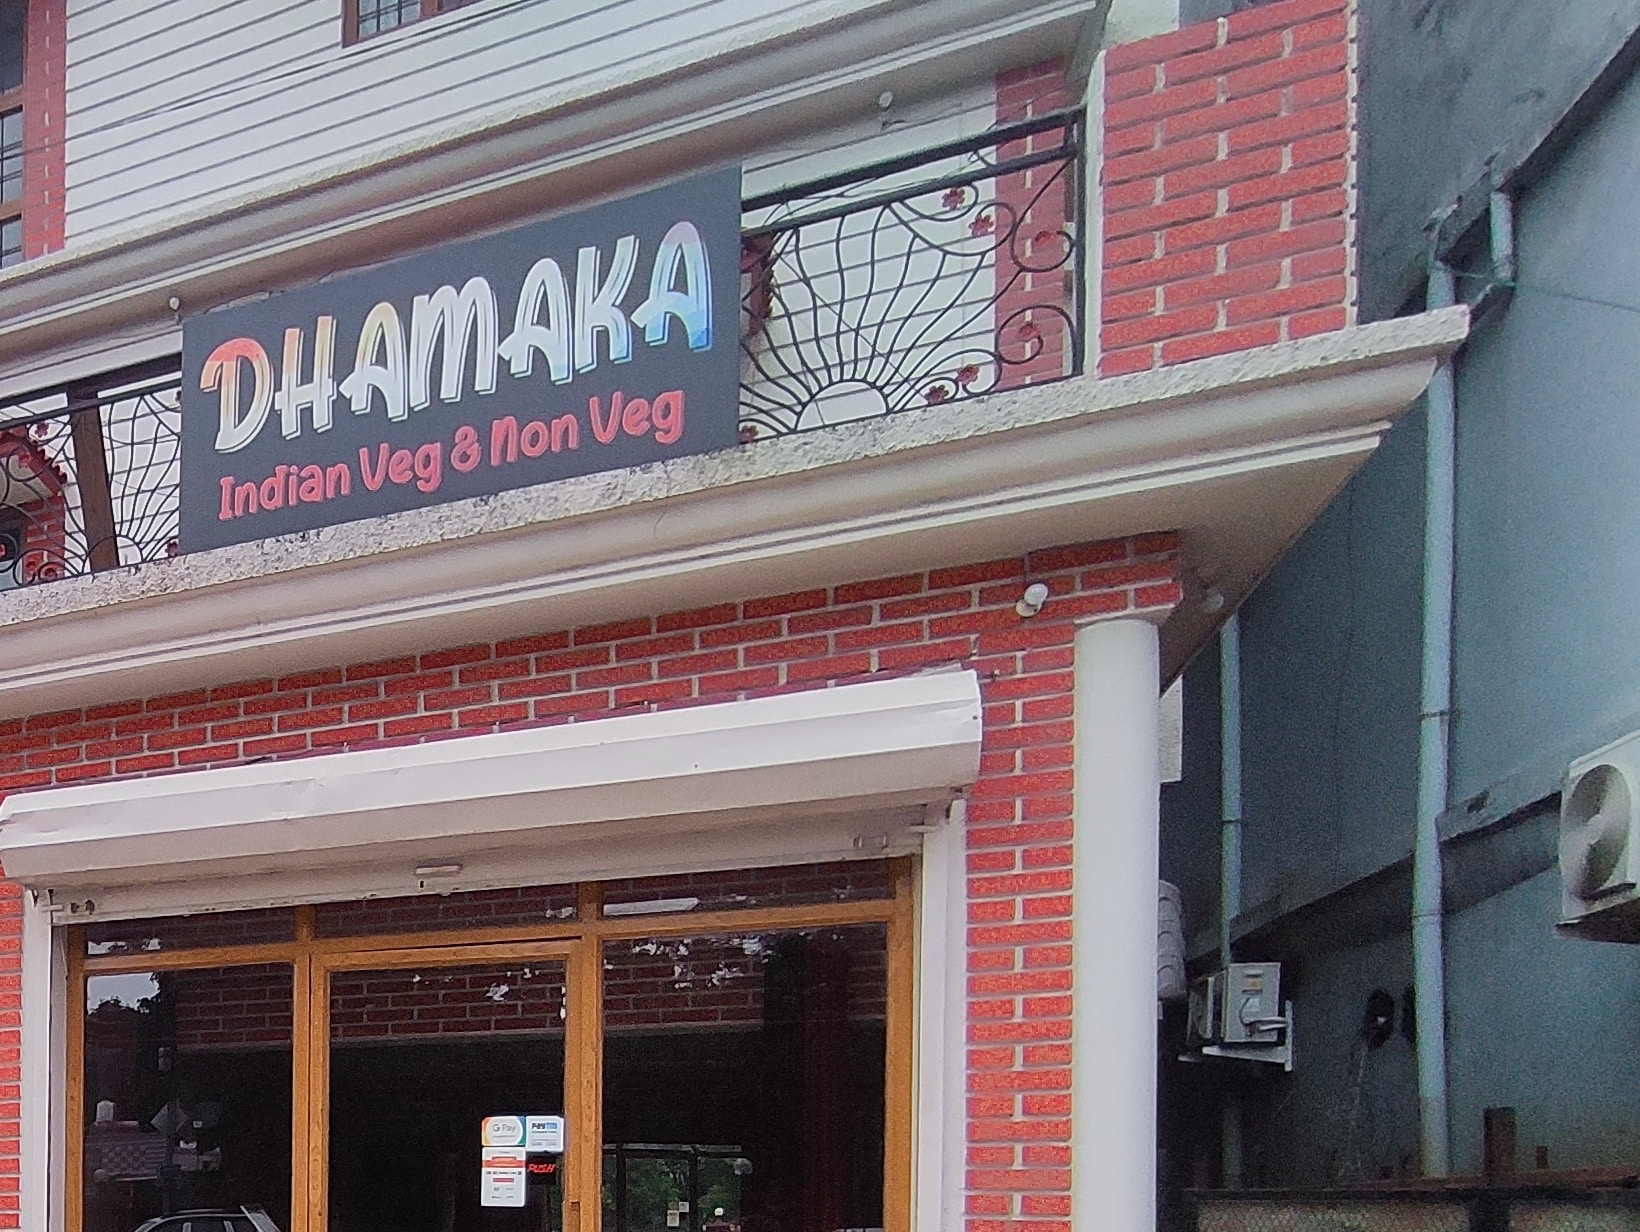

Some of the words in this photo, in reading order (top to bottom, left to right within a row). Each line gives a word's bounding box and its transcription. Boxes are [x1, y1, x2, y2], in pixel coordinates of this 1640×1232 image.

[199, 221, 712, 454] DHAMAKA
[218, 464, 350, 520] Indian
[359, 440, 443, 493] Veg
[450, 431, 482, 472] &
[489, 411, 579, 466] Non
[588, 389, 685, 445] Veg
